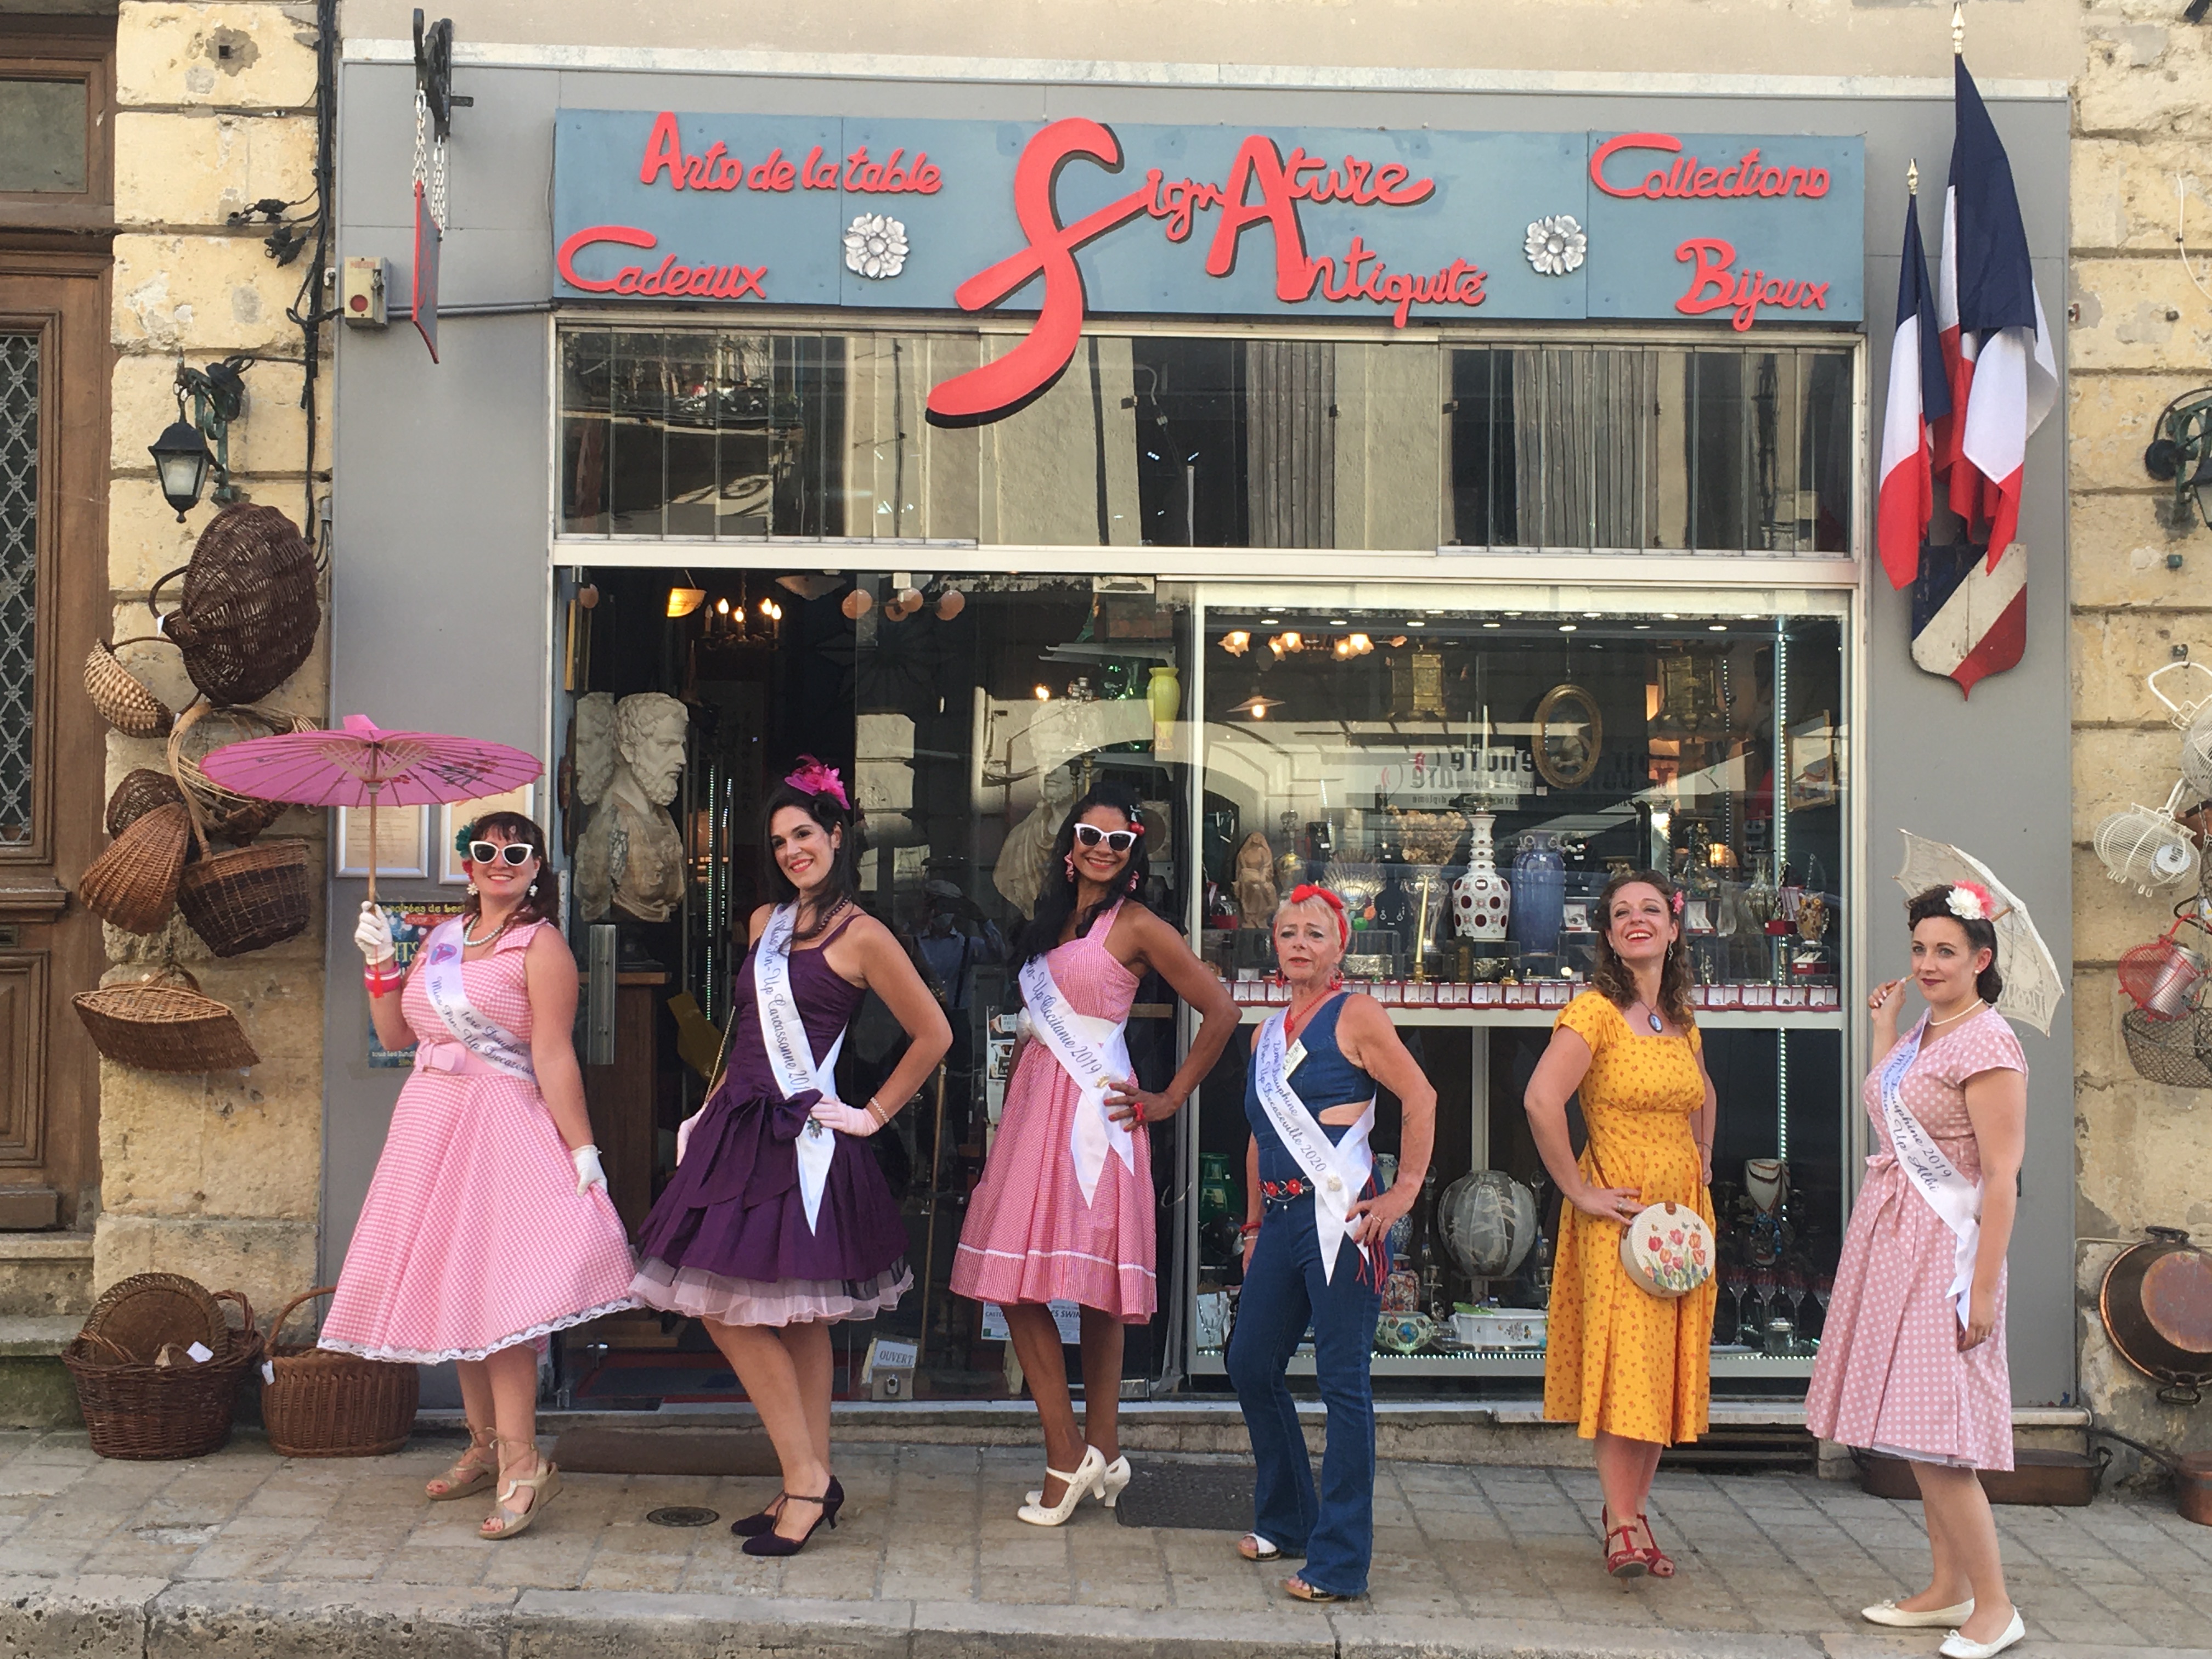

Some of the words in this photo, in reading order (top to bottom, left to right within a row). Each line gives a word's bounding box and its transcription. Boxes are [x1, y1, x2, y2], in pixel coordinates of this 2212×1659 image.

[640, 112, 743, 190] Arts
[747, 148, 795, 191] de
[802, 145, 841, 190] la
[843, 146, 943, 194] table
[1591, 133, 1830, 199] Collections
[557, 225, 767, 298] Cadeaux
[1675, 238, 1829, 332] Bijoux
[428, 904, 441, 912] de
[432, 976, 443, 1006] Miss
[767, 992, 797, 1070] Carcassonne
[787, 1069, 813, 1091] 201
[1040, 995, 1076, 1048] Occitanie
[1070, 1046, 1103, 1075] 2019
[1272, 1063, 1299, 1116] Dauphine
[1262, 1082, 1303, 1146] Decazeville
[1300, 1143, 1327, 1172] 2020
[1907, 1155, 1938, 1193] Albi
[1922, 1147, 1953, 1178] 2019
[1060, 1310, 1080, 1318] SWIN
[879, 1349, 915, 1367] OUVERT
